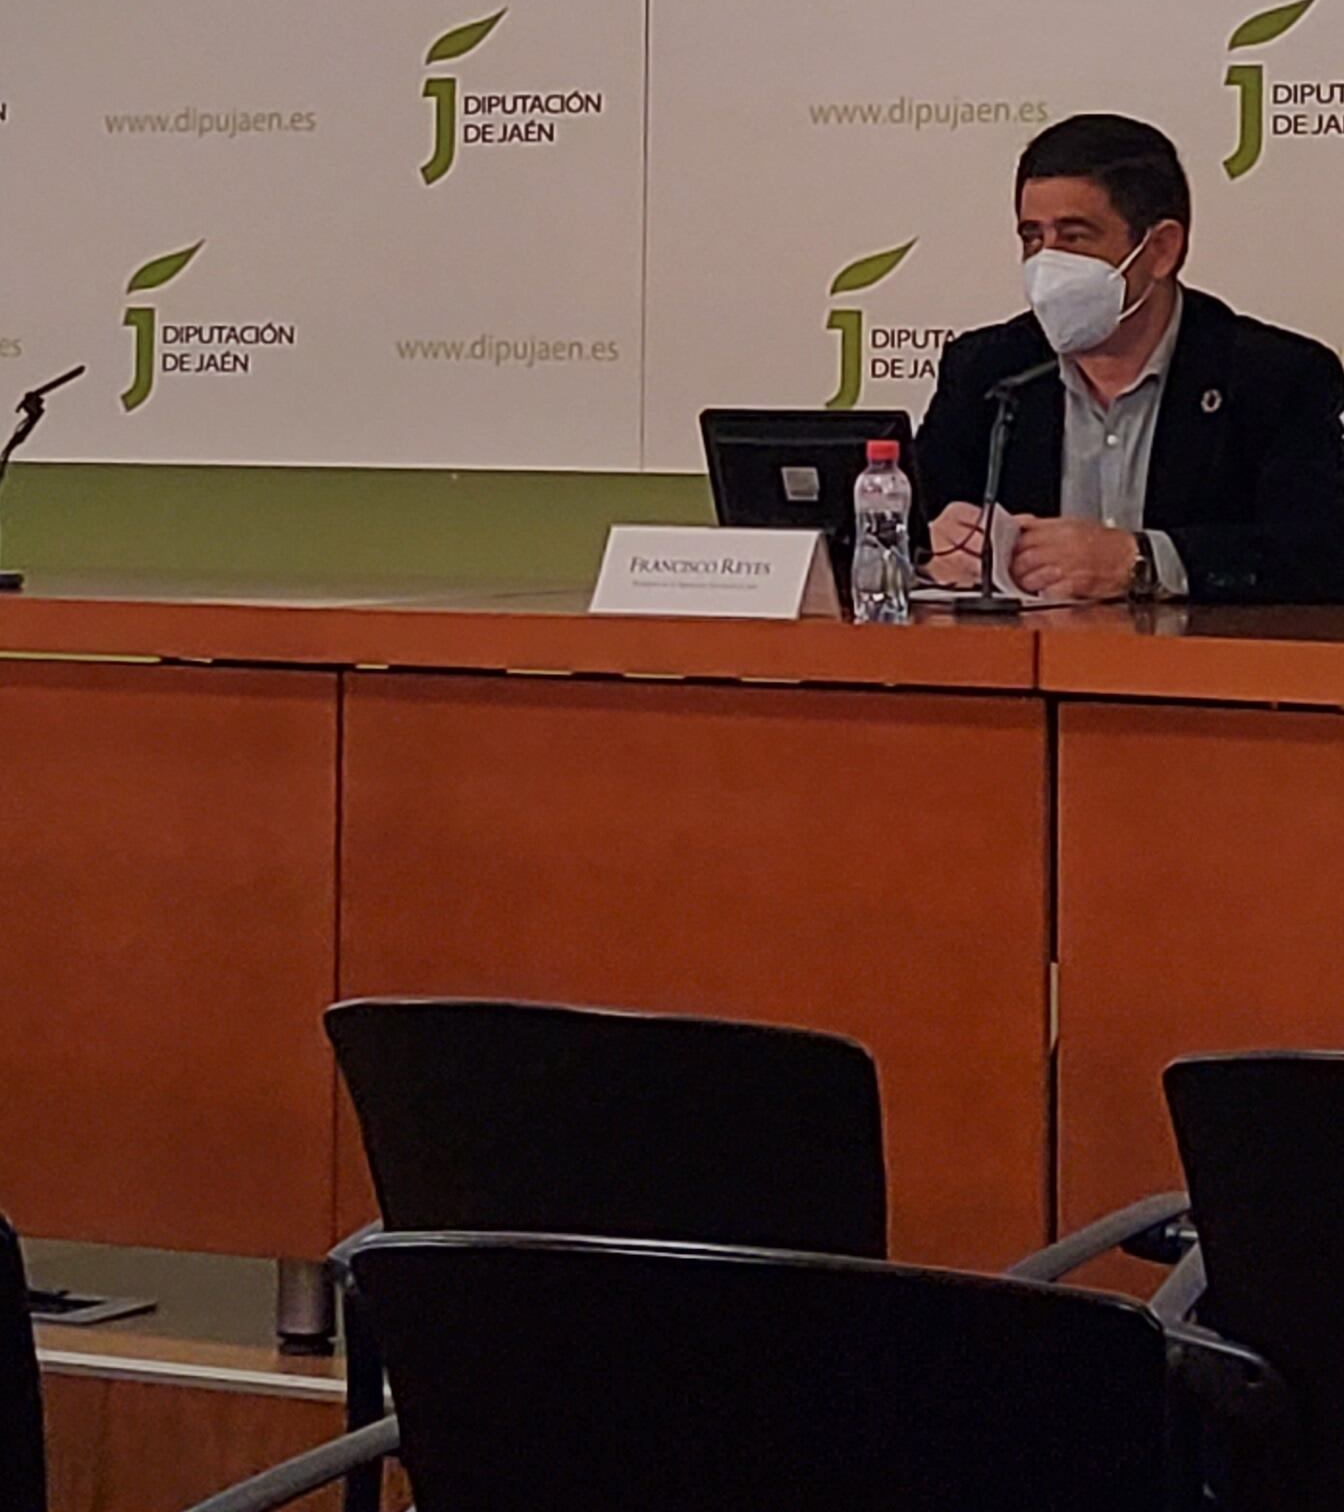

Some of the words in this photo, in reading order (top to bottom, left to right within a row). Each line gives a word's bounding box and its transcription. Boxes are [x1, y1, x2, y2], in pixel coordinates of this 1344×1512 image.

[462, 90, 603, 116] DIPUTACIÓN
[808, 95, 1049, 131] www.dipujaen.es
[103, 106, 318, 139] www.dipujaen.es
[462, 122, 495, 144] DE
[497, 118, 555, 144] JAÉN
[1271, 114, 1309, 135] DE
[161, 321, 296, 346] DIPUTACIÓN
[161, 352, 192, 373] DE
[193, 350, 251, 373] JAÉN
[394, 333, 620, 368] www.dipujaen.es
[870, 357, 905, 380] DE
[629, 556, 717, 574] FRANCISCO
[721, 559, 772, 576] REYES
